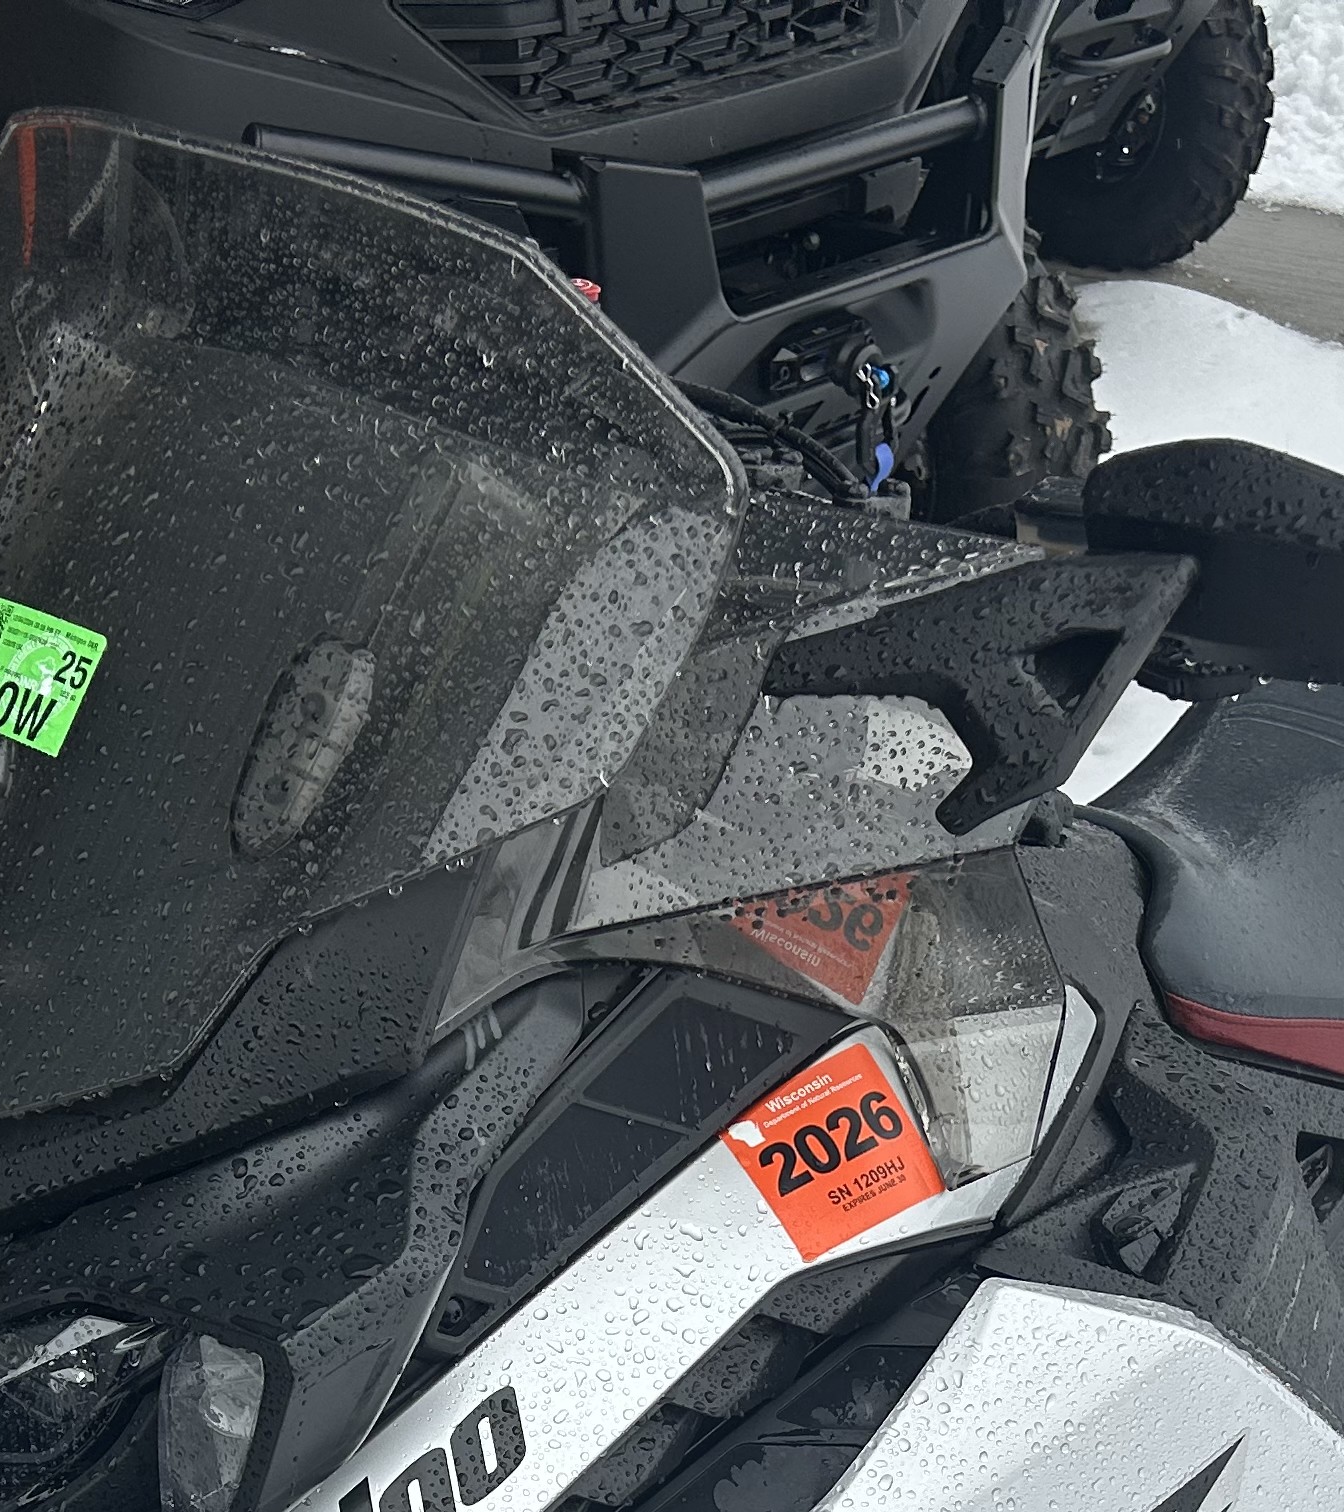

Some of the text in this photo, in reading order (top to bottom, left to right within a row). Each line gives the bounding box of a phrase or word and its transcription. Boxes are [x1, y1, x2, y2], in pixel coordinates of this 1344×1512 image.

[53, 650, 93, 690] 25
[763, 1099, 801, 1129] Department
[807, 1087, 832, 1107] Natural
[829, 1073, 864, 1096] Resources
[765, 1073, 833, 1112] Wisconsin
[759, 1091, 903, 1197] 2026
[828, 1156, 906, 1205] SN 1209HJ
[842, 1189, 877, 1212] EXPIRES
[877, 1179, 898, 1194] JUNE
